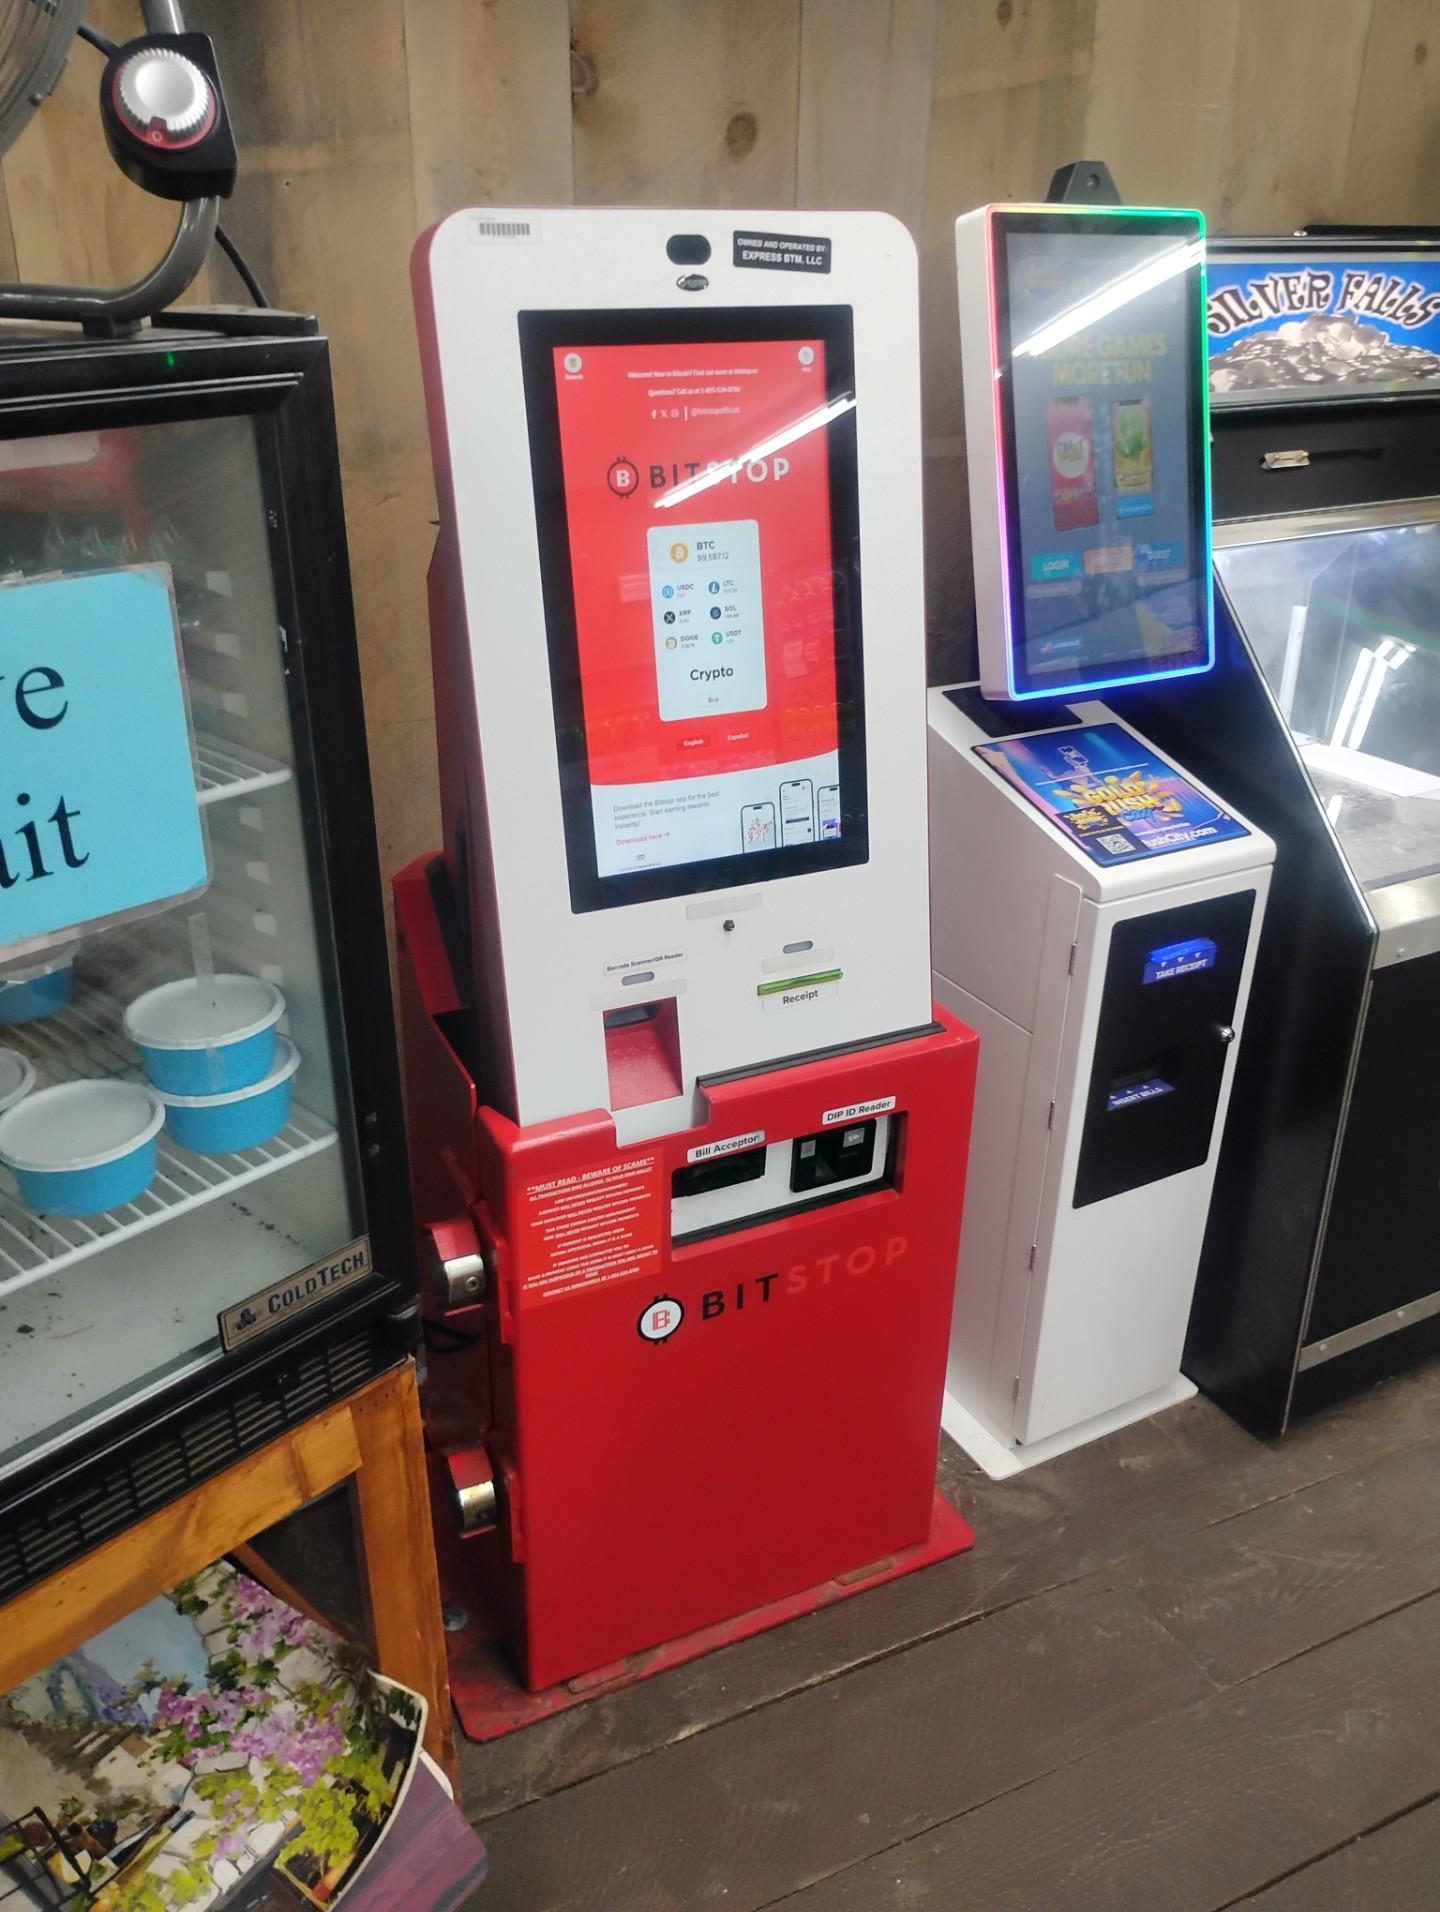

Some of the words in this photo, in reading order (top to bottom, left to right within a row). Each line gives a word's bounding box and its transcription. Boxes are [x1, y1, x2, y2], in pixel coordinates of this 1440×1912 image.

[737, 238, 762, 248] OWNED
[764, 240, 778, 249] AND
[780, 241, 815, 252] OPERATED
[742, 250, 782, 262] EXPRESS
[784, 253, 805, 265] BTM,
[806, 256, 823, 266] LLC
[1336, 271, 1440, 328] FALLS
[696, 541, 715, 551] BTC
[690, 666, 734, 682] Crypto
[606, 963, 630, 972] Barcode
[664, 952, 683, 960] Reader
[1156, 967, 1175, 980] TAKE
[1176, 958, 1209, 975] RECEIPT
[783, 988, 819, 1006] Receipt
[827, 1110, 843, 1122] DIP
[846, 1107, 856, 1117] ID
[858, 1100, 891, 1115] Reader
[695, 1147, 711, 1159] Bill
[713, 1135, 759, 1155] Acceptor
[267, 1250, 364, 1314] COLDTECH
[702, 1236, 908, 1321] BITSTOP
